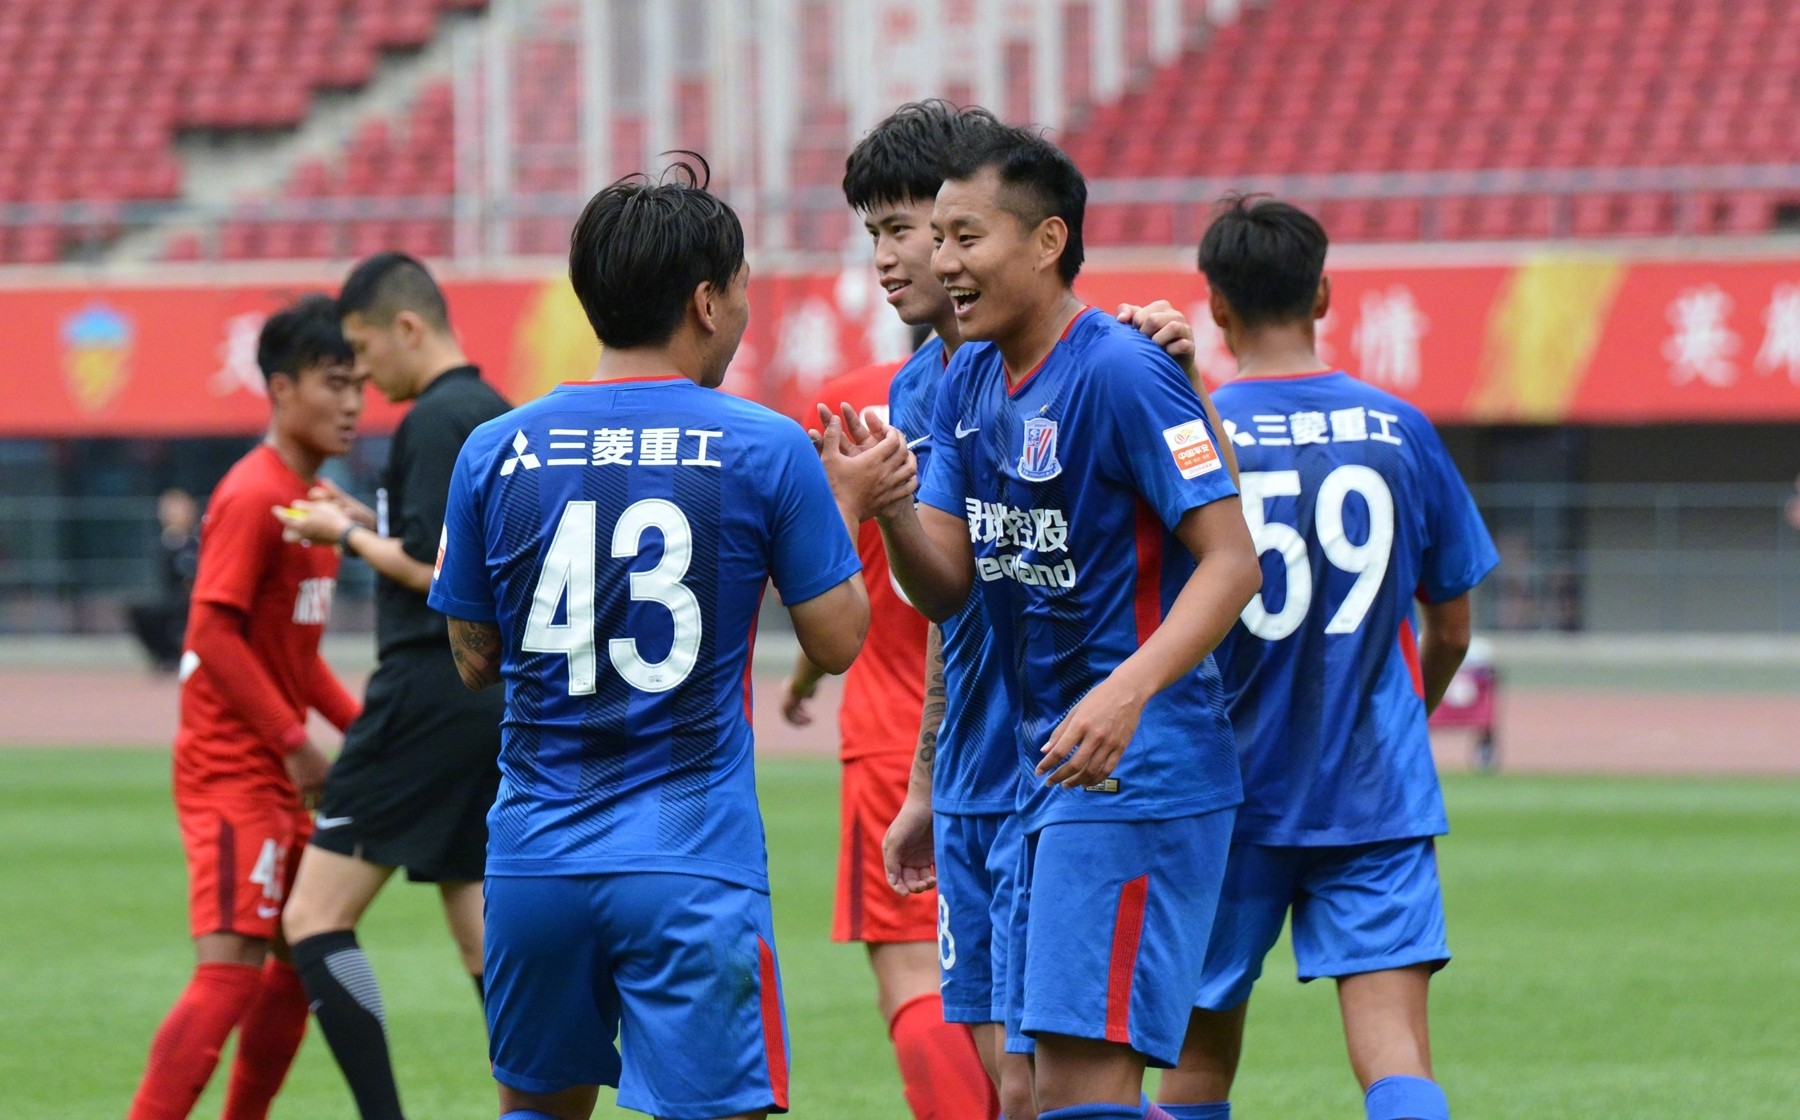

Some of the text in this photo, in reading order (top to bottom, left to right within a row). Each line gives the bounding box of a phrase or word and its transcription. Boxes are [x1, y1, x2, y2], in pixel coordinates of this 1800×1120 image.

[547, 427, 723, 467] 三菱重工
[1252, 407, 1402, 446] 三菱重工
[520, 498, 702, 696] 43
[1239, 464, 1395, 641] 59
